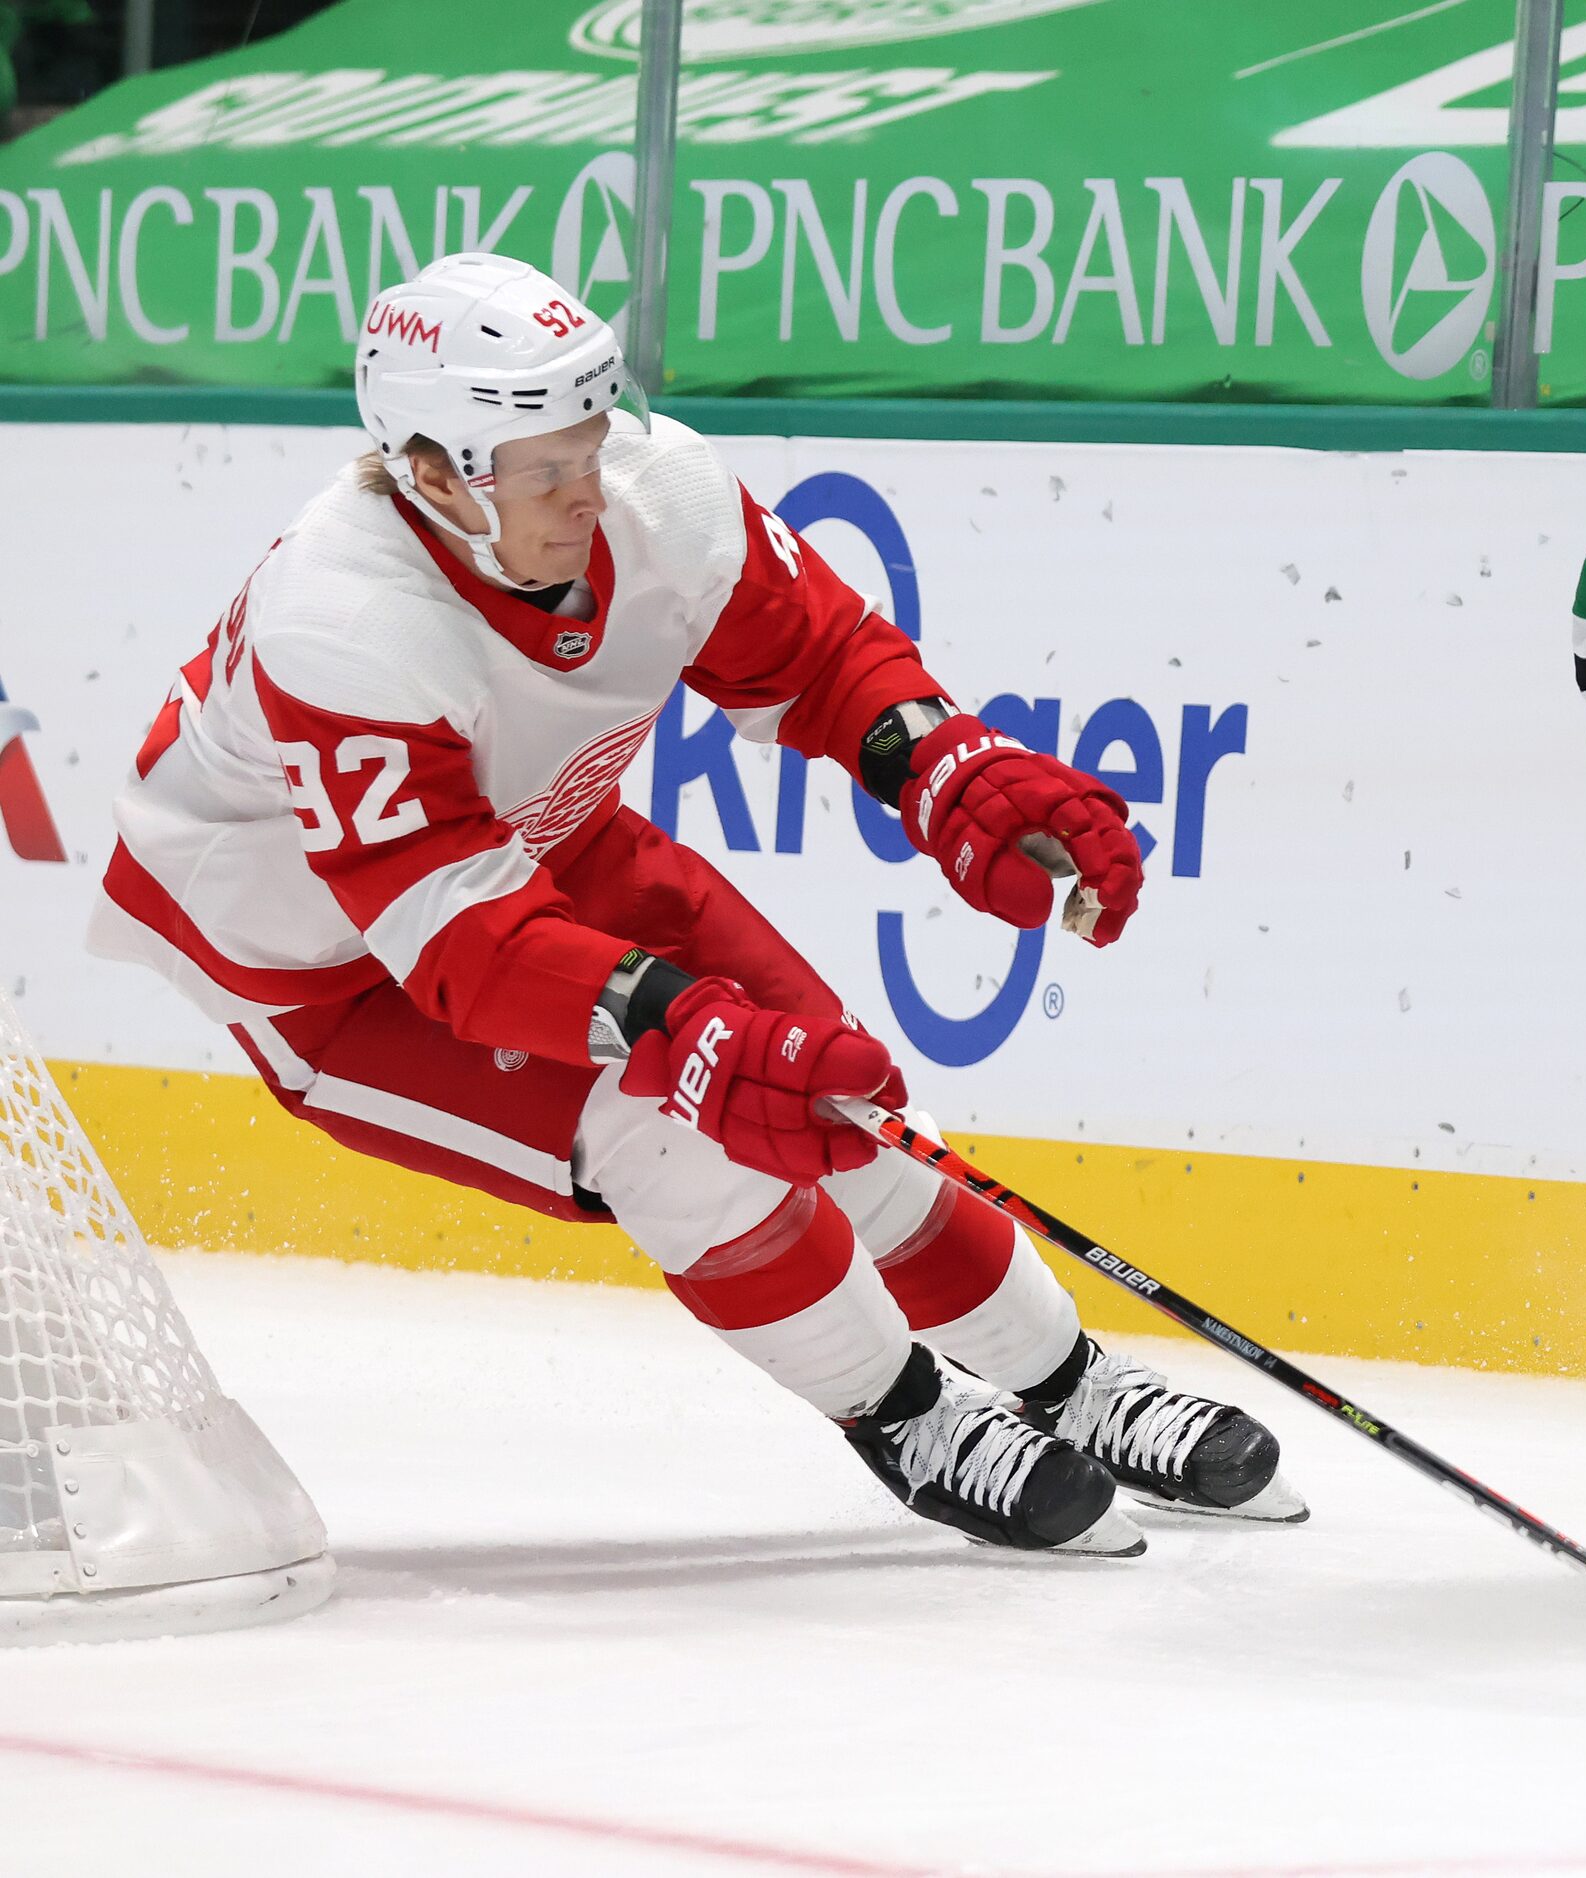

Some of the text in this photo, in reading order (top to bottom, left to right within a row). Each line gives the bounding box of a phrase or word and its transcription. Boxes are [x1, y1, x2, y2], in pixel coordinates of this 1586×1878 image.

[689, 176, 959, 345] PNC
[971, 177, 1344, 347] BANK
[367, 301, 443, 353] UWM
[533, 300, 585, 338] 92
[275, 734, 430, 853] 92
[1084, 1245, 1161, 1296] BAUER
[1202, 1317, 1265, 1361] NAMESTNIKOV
